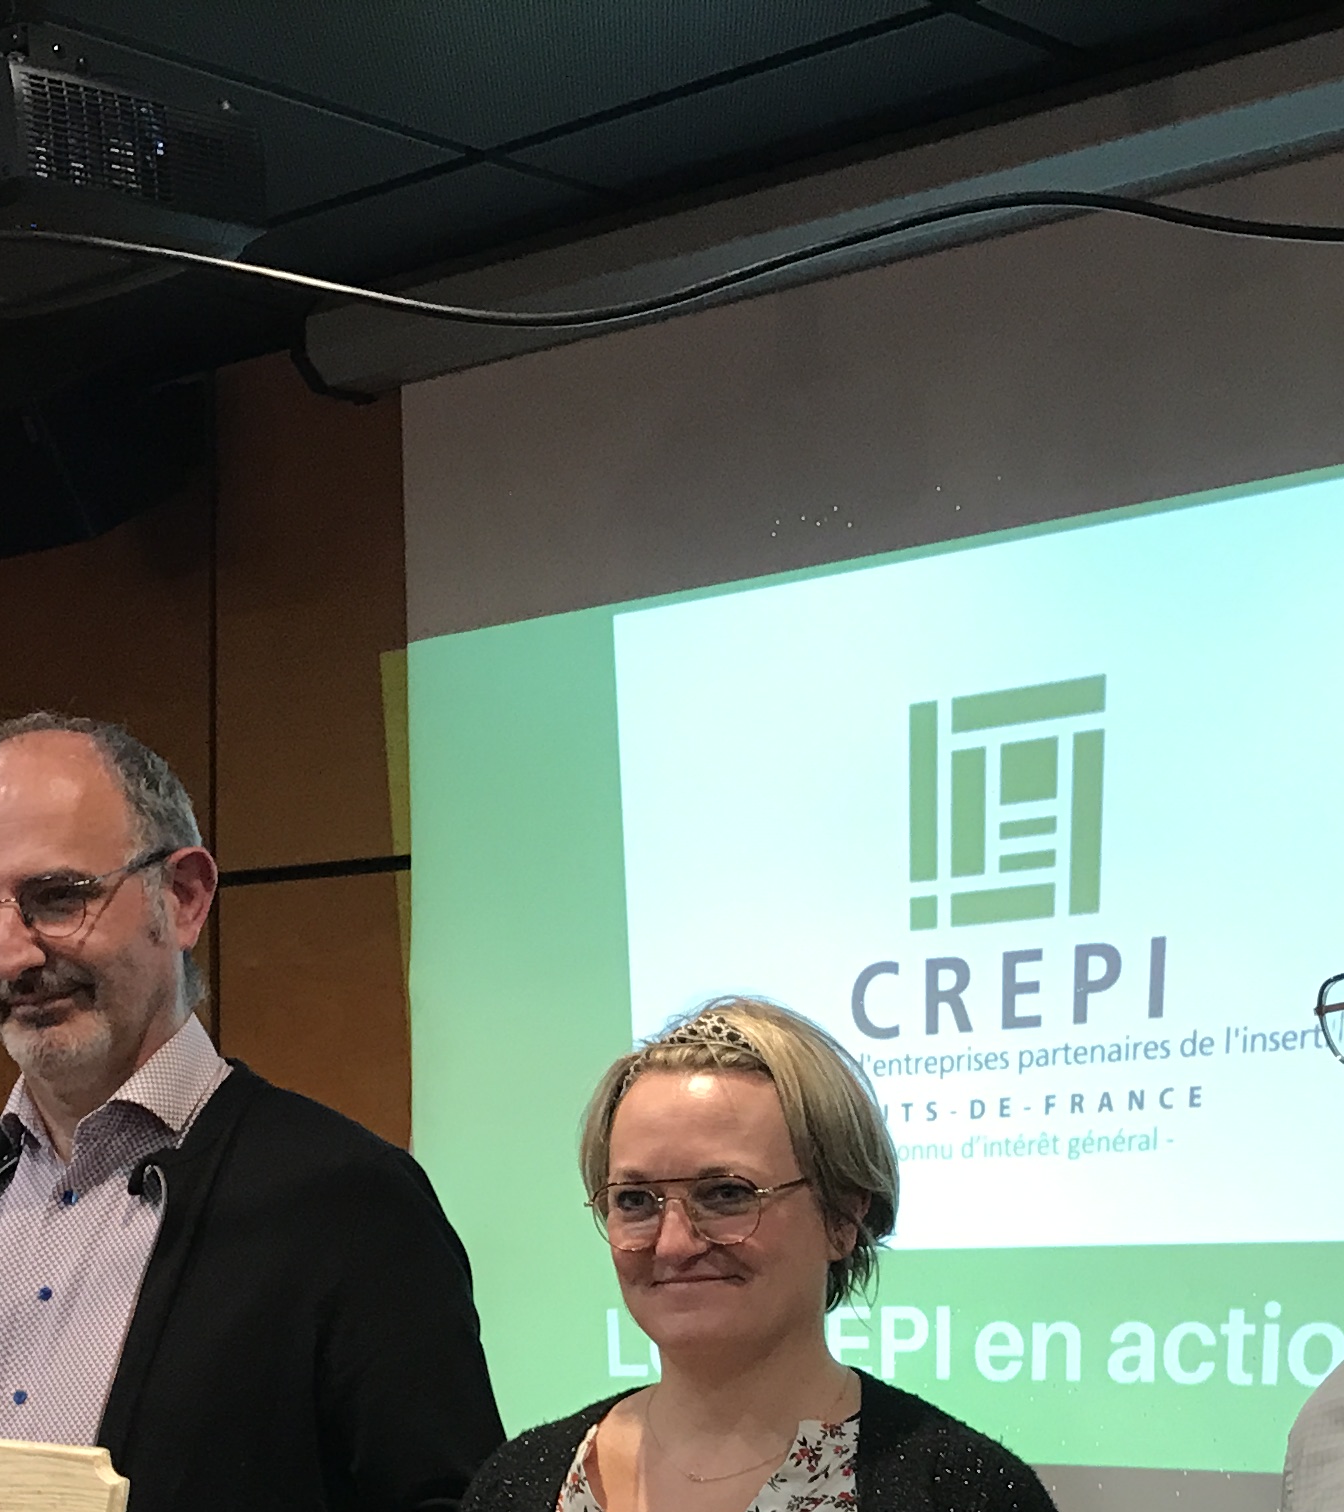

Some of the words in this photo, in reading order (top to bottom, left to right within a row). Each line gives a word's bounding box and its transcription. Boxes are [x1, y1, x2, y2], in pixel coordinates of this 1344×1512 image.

[850, 936, 1167, 1041] CREPI
[1018, 1035, 1171, 1075] partenaires
[1180, 1029, 1215, 1058] de
[1225, 1024, 1328, 1054] l'insert
[897, 1143, 953, 1163] onnu
[1068, 1126, 1158, 1161] général
[606, 1308, 662, 1383] L
[824, 1305, 951, 1381] EPI
[974, 1322, 1082, 1383] en
